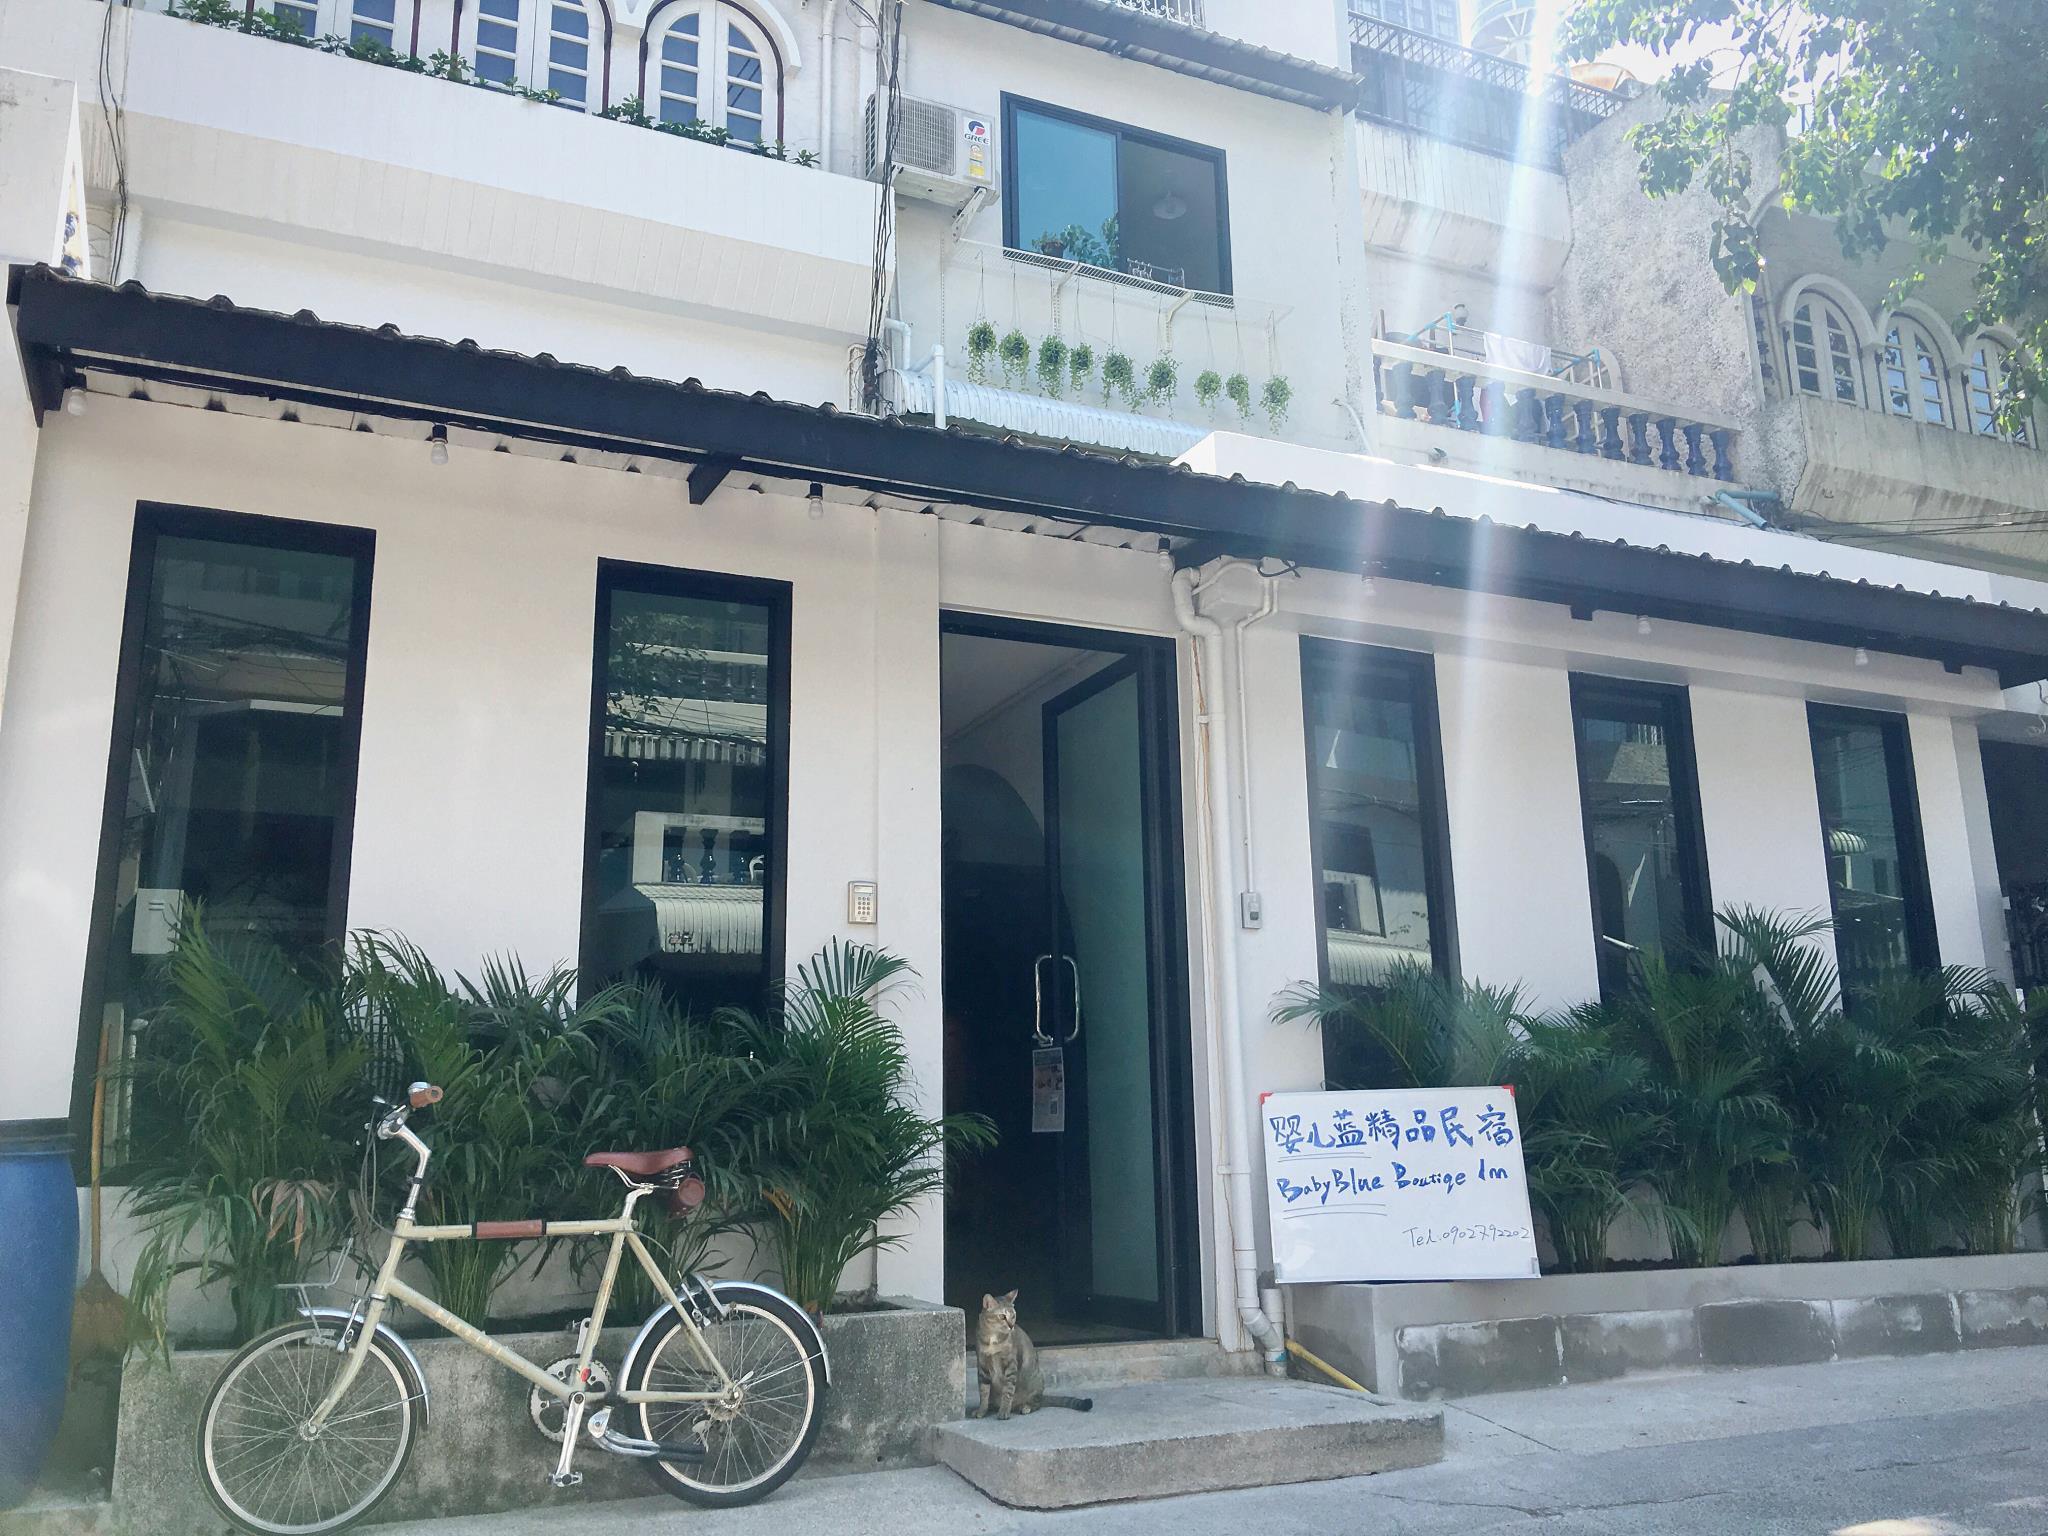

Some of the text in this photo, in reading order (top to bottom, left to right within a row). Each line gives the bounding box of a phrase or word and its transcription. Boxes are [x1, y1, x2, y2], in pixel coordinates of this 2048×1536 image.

[964, 133, 990, 145] GREE
[1269, 1104, 1514, 1154] 婴儿蓝精品民宿
[1478, 1158, 1509, 1181] Inn
